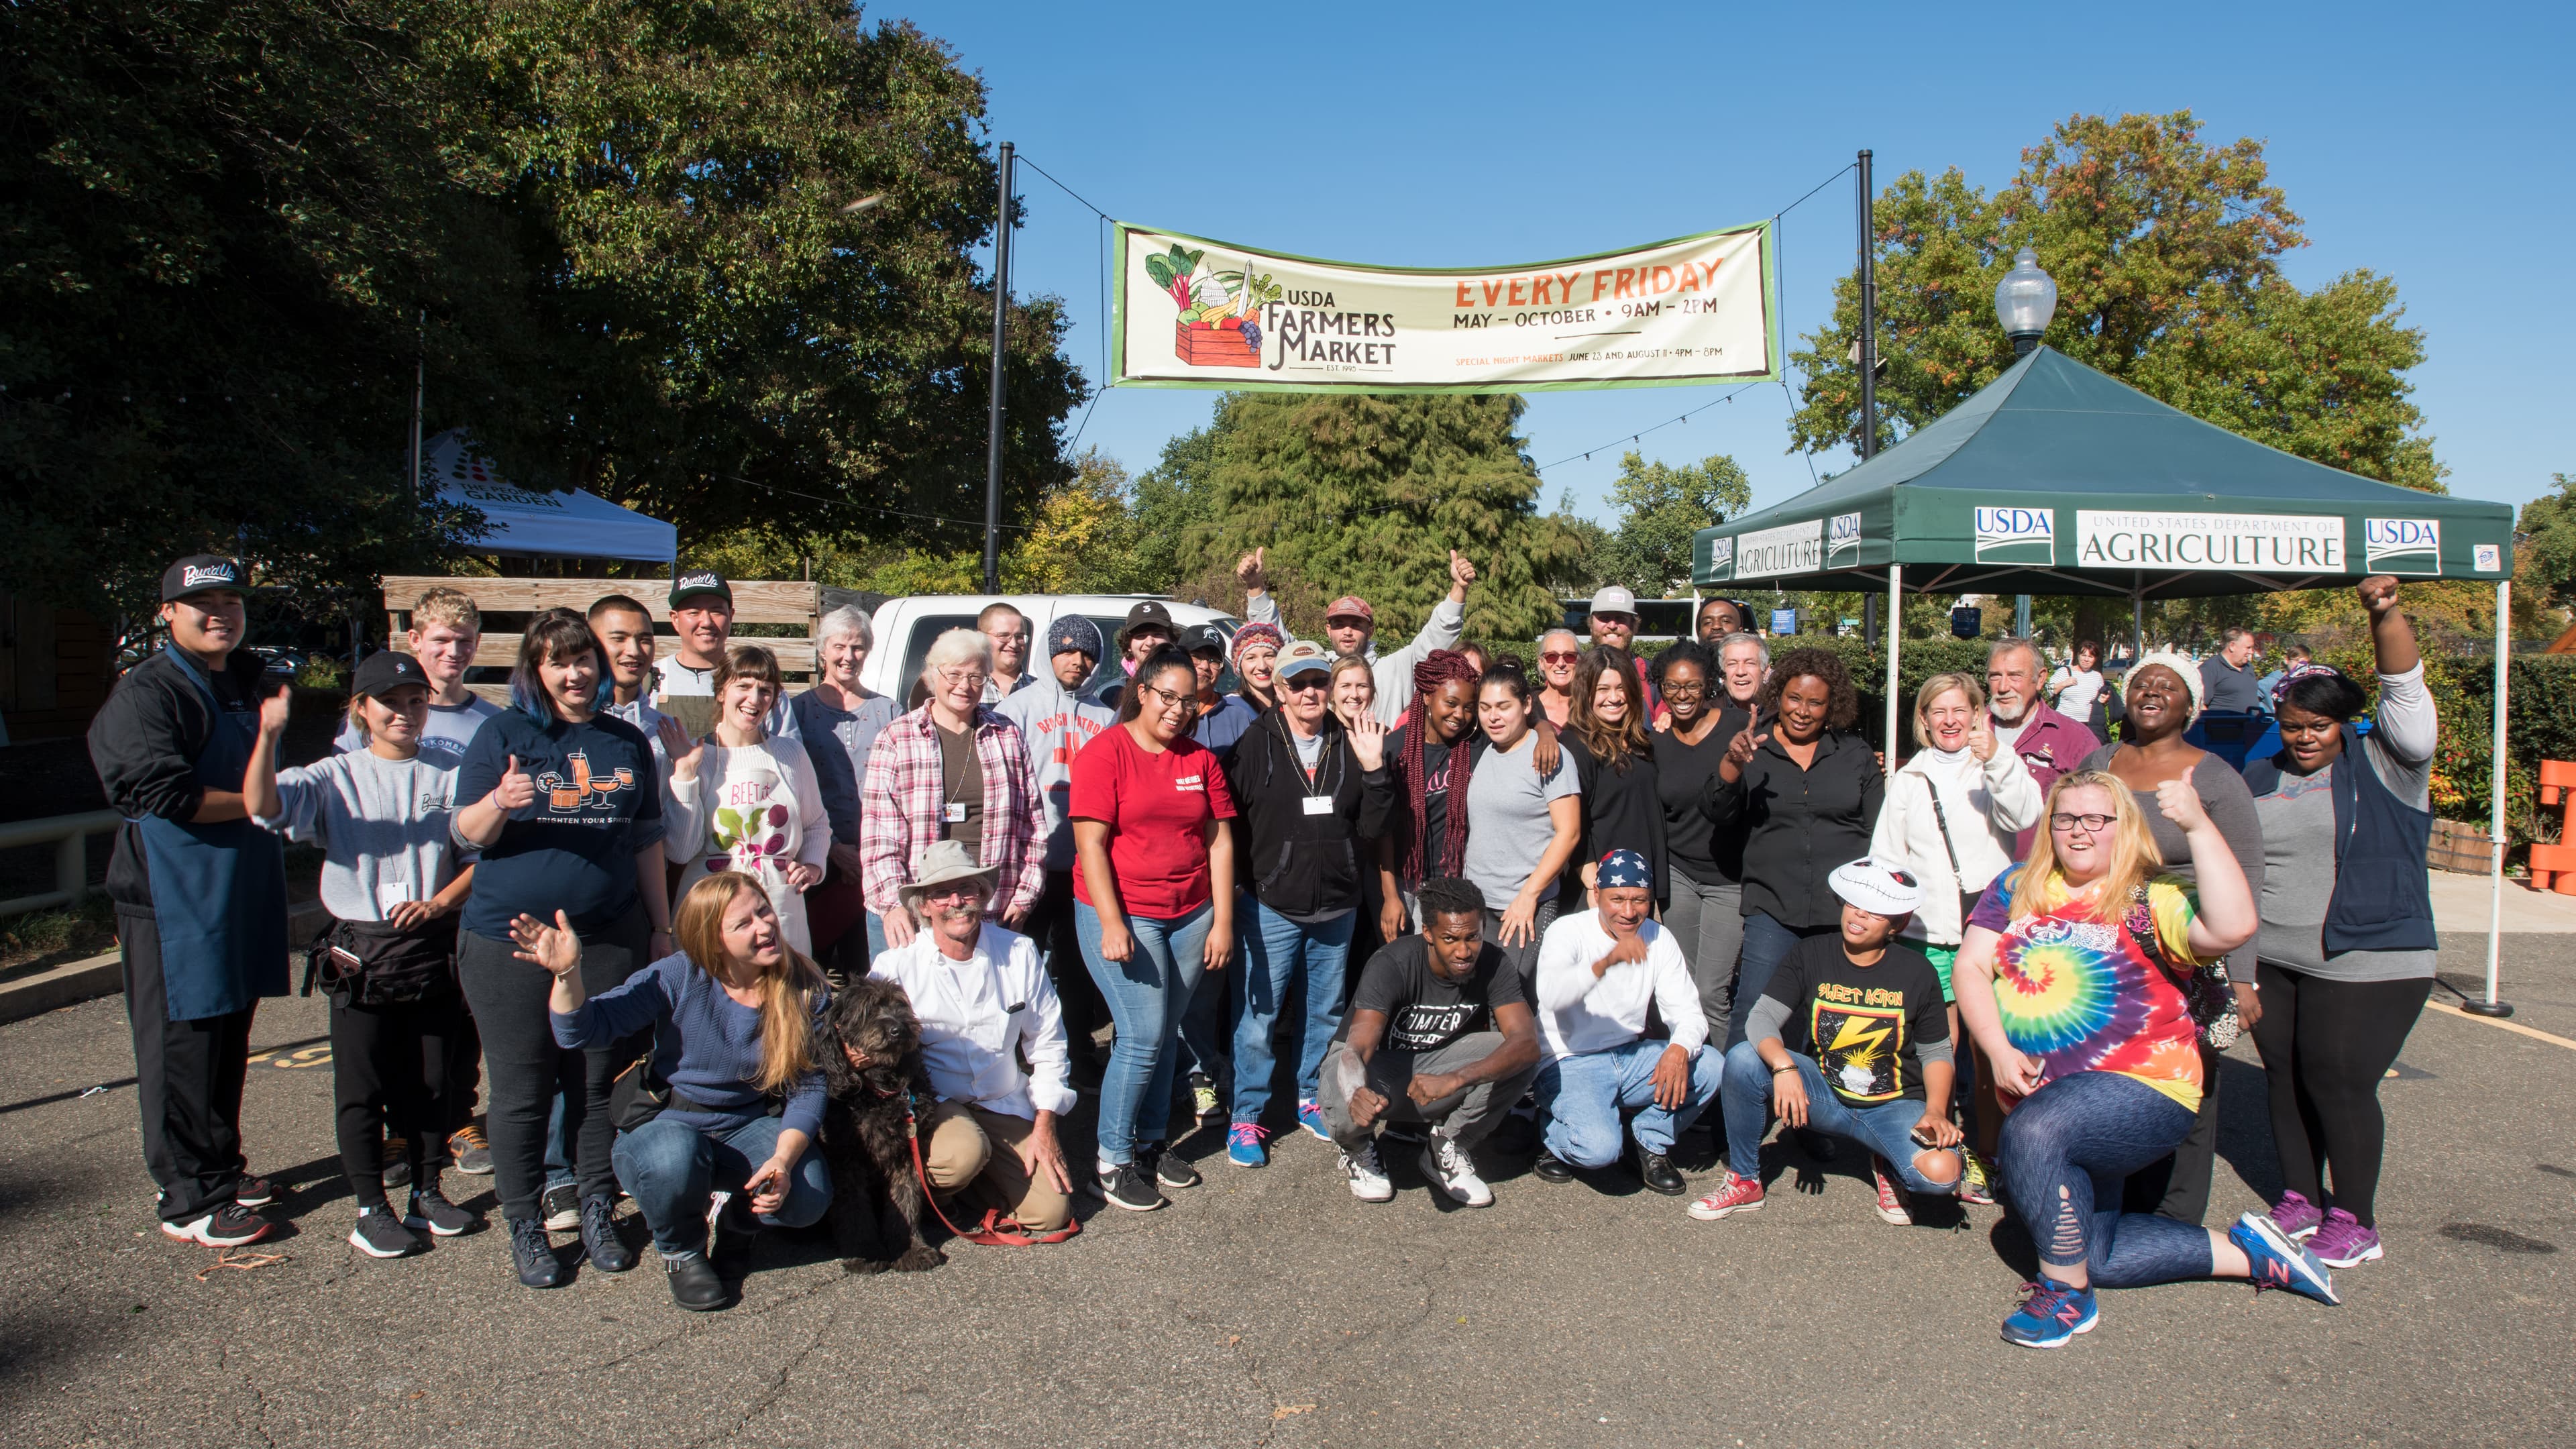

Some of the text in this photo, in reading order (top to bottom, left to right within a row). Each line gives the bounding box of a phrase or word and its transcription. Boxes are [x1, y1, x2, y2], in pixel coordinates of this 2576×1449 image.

[1455, 257, 1725, 307] EVERY FRIDAY
[1288, 290, 1336, 308] USDA
[1258, 300, 1396, 337] FARMERS
[1454, 313, 1493, 329] MAY
[1515, 309, 1596, 327] OCTOBER
[1621, 300, 1660, 319] 9AM
[1682, 297, 1717, 315] 2PM
[1268, 328, 1396, 371] MARKET
[1456, 356, 1491, 366] SPECIAL
[1493, 355, 1520, 365] NIGHT
[1523, 353, 1564, 364] MARKETS
[1568, 352, 1589, 362] JUNE
[1592, 352, 1603, 361] 23
[1605, 351, 1624, 360] AND
[1626, 349, 1660, 359] AUGUST
[1674, 347, 1692, 358] 4PM
[1703, 347, 1723, 358] 8PM
[458, 483, 489, 491] THE
[465, 490, 564, 508] GARDEN
[1829, 515, 1860, 541] USDA
[1977, 508, 2051, 534] USDA
[2094, 515, 2335, 533] UNITED STATES DEPARTMENT OF
[2367, 520, 2436, 545] USDA
[1712, 539, 1731, 559] USDA
[1738, 538, 1820, 574] AGRICULTURE
[2082, 531, 2341, 567] AGRICULTURE
[1142, 605, 1151, 613] 3
[1071, 713, 1106, 735] ATRO
[731, 782, 760, 806] BEET
[1818, 983, 1903, 1008] SWEET ACTION
